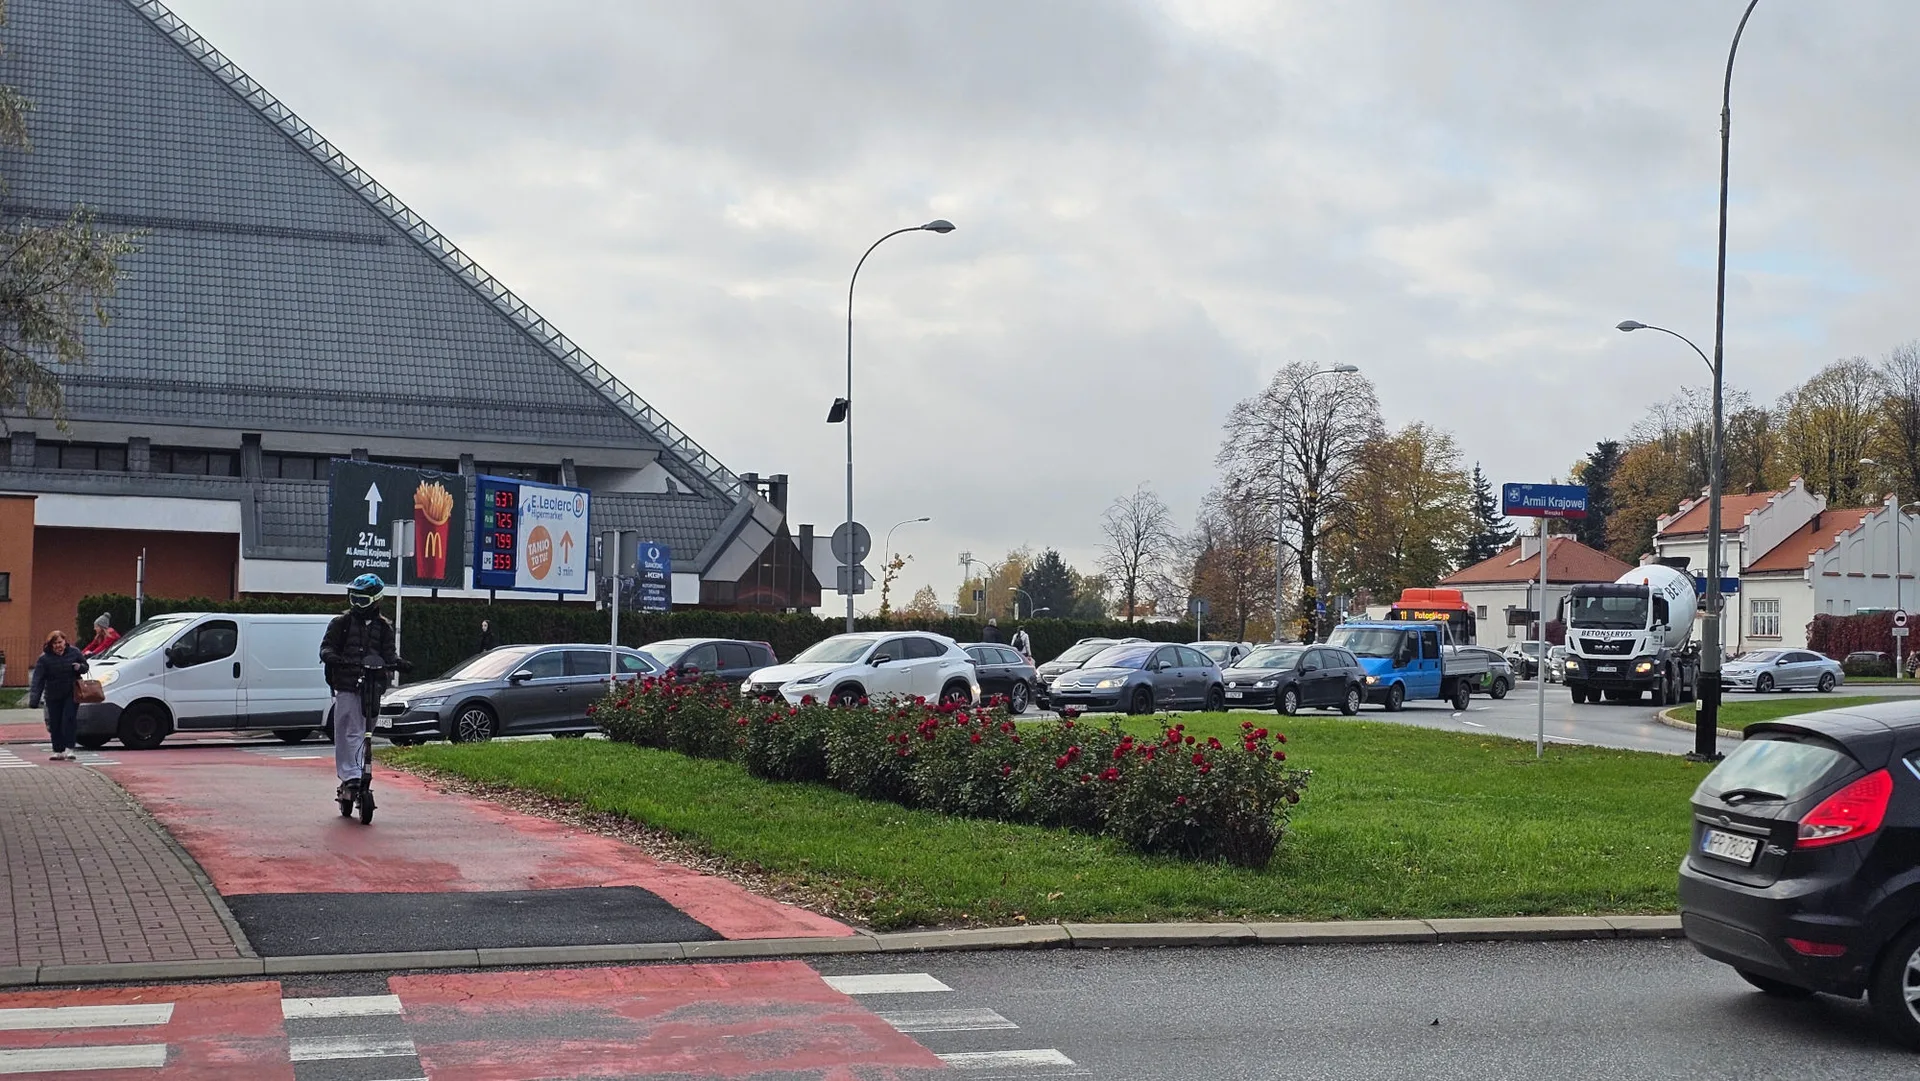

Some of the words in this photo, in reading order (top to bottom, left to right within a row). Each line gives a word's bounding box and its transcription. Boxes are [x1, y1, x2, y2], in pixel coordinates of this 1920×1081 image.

[531, 495, 572, 512] E.Leclerc
[1522, 495, 1546, 507] Armii
[1548, 496, 1586, 511] Krajowej
[531, 510, 563, 521] Hipermarket
[358, 532, 374, 548] 2,7
[374, 537, 386, 547] km
[528, 538, 550, 555] TANIO
[353, 558, 366, 568] przy
[563, 567, 573, 576] min
[1400, 610, 1408, 620] 11
